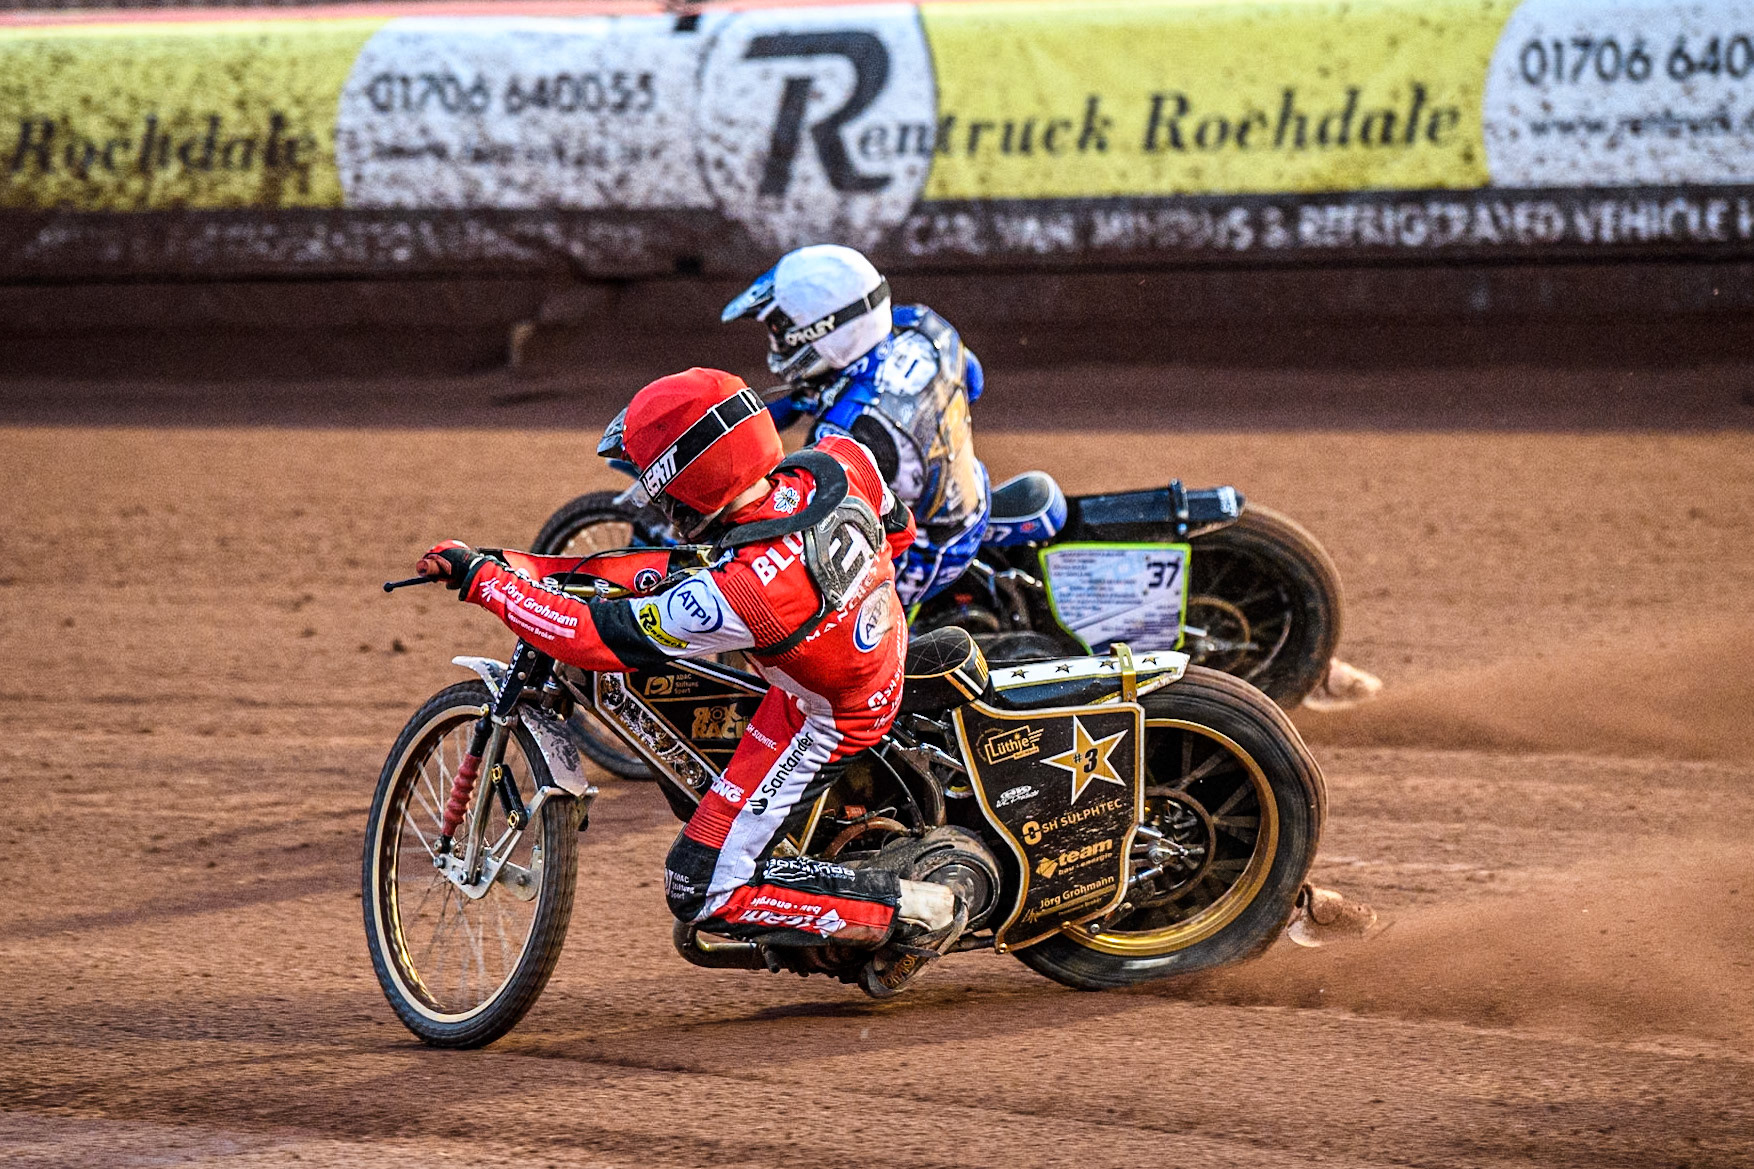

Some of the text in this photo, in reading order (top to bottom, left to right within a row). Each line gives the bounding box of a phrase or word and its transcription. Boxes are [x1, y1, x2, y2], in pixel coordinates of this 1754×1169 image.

[1519, 36, 1653, 86] 01706
[366, 71, 488, 115] 01706
[1139, 82, 1461, 154] Rochdale
[8, 110, 318, 178] Rochdale
[784, 314, 836, 347] OAKLEY
[829, 522, 867, 596] 2
[1146, 561, 1180, 589] 37
[501, 580, 578, 627] Jörg Grohmann
[677, 590, 712, 627] ATPI
[534, 627, 556, 641] Broker
[990, 733, 1030, 757] Lüthje
[761, 731, 814, 798] Santander
[1041, 819, 1058, 833] SH
[1058, 838, 1113, 867] team
[1040, 895, 1061, 909] Jörg
[1062, 875, 1115, 900] Grohmann
